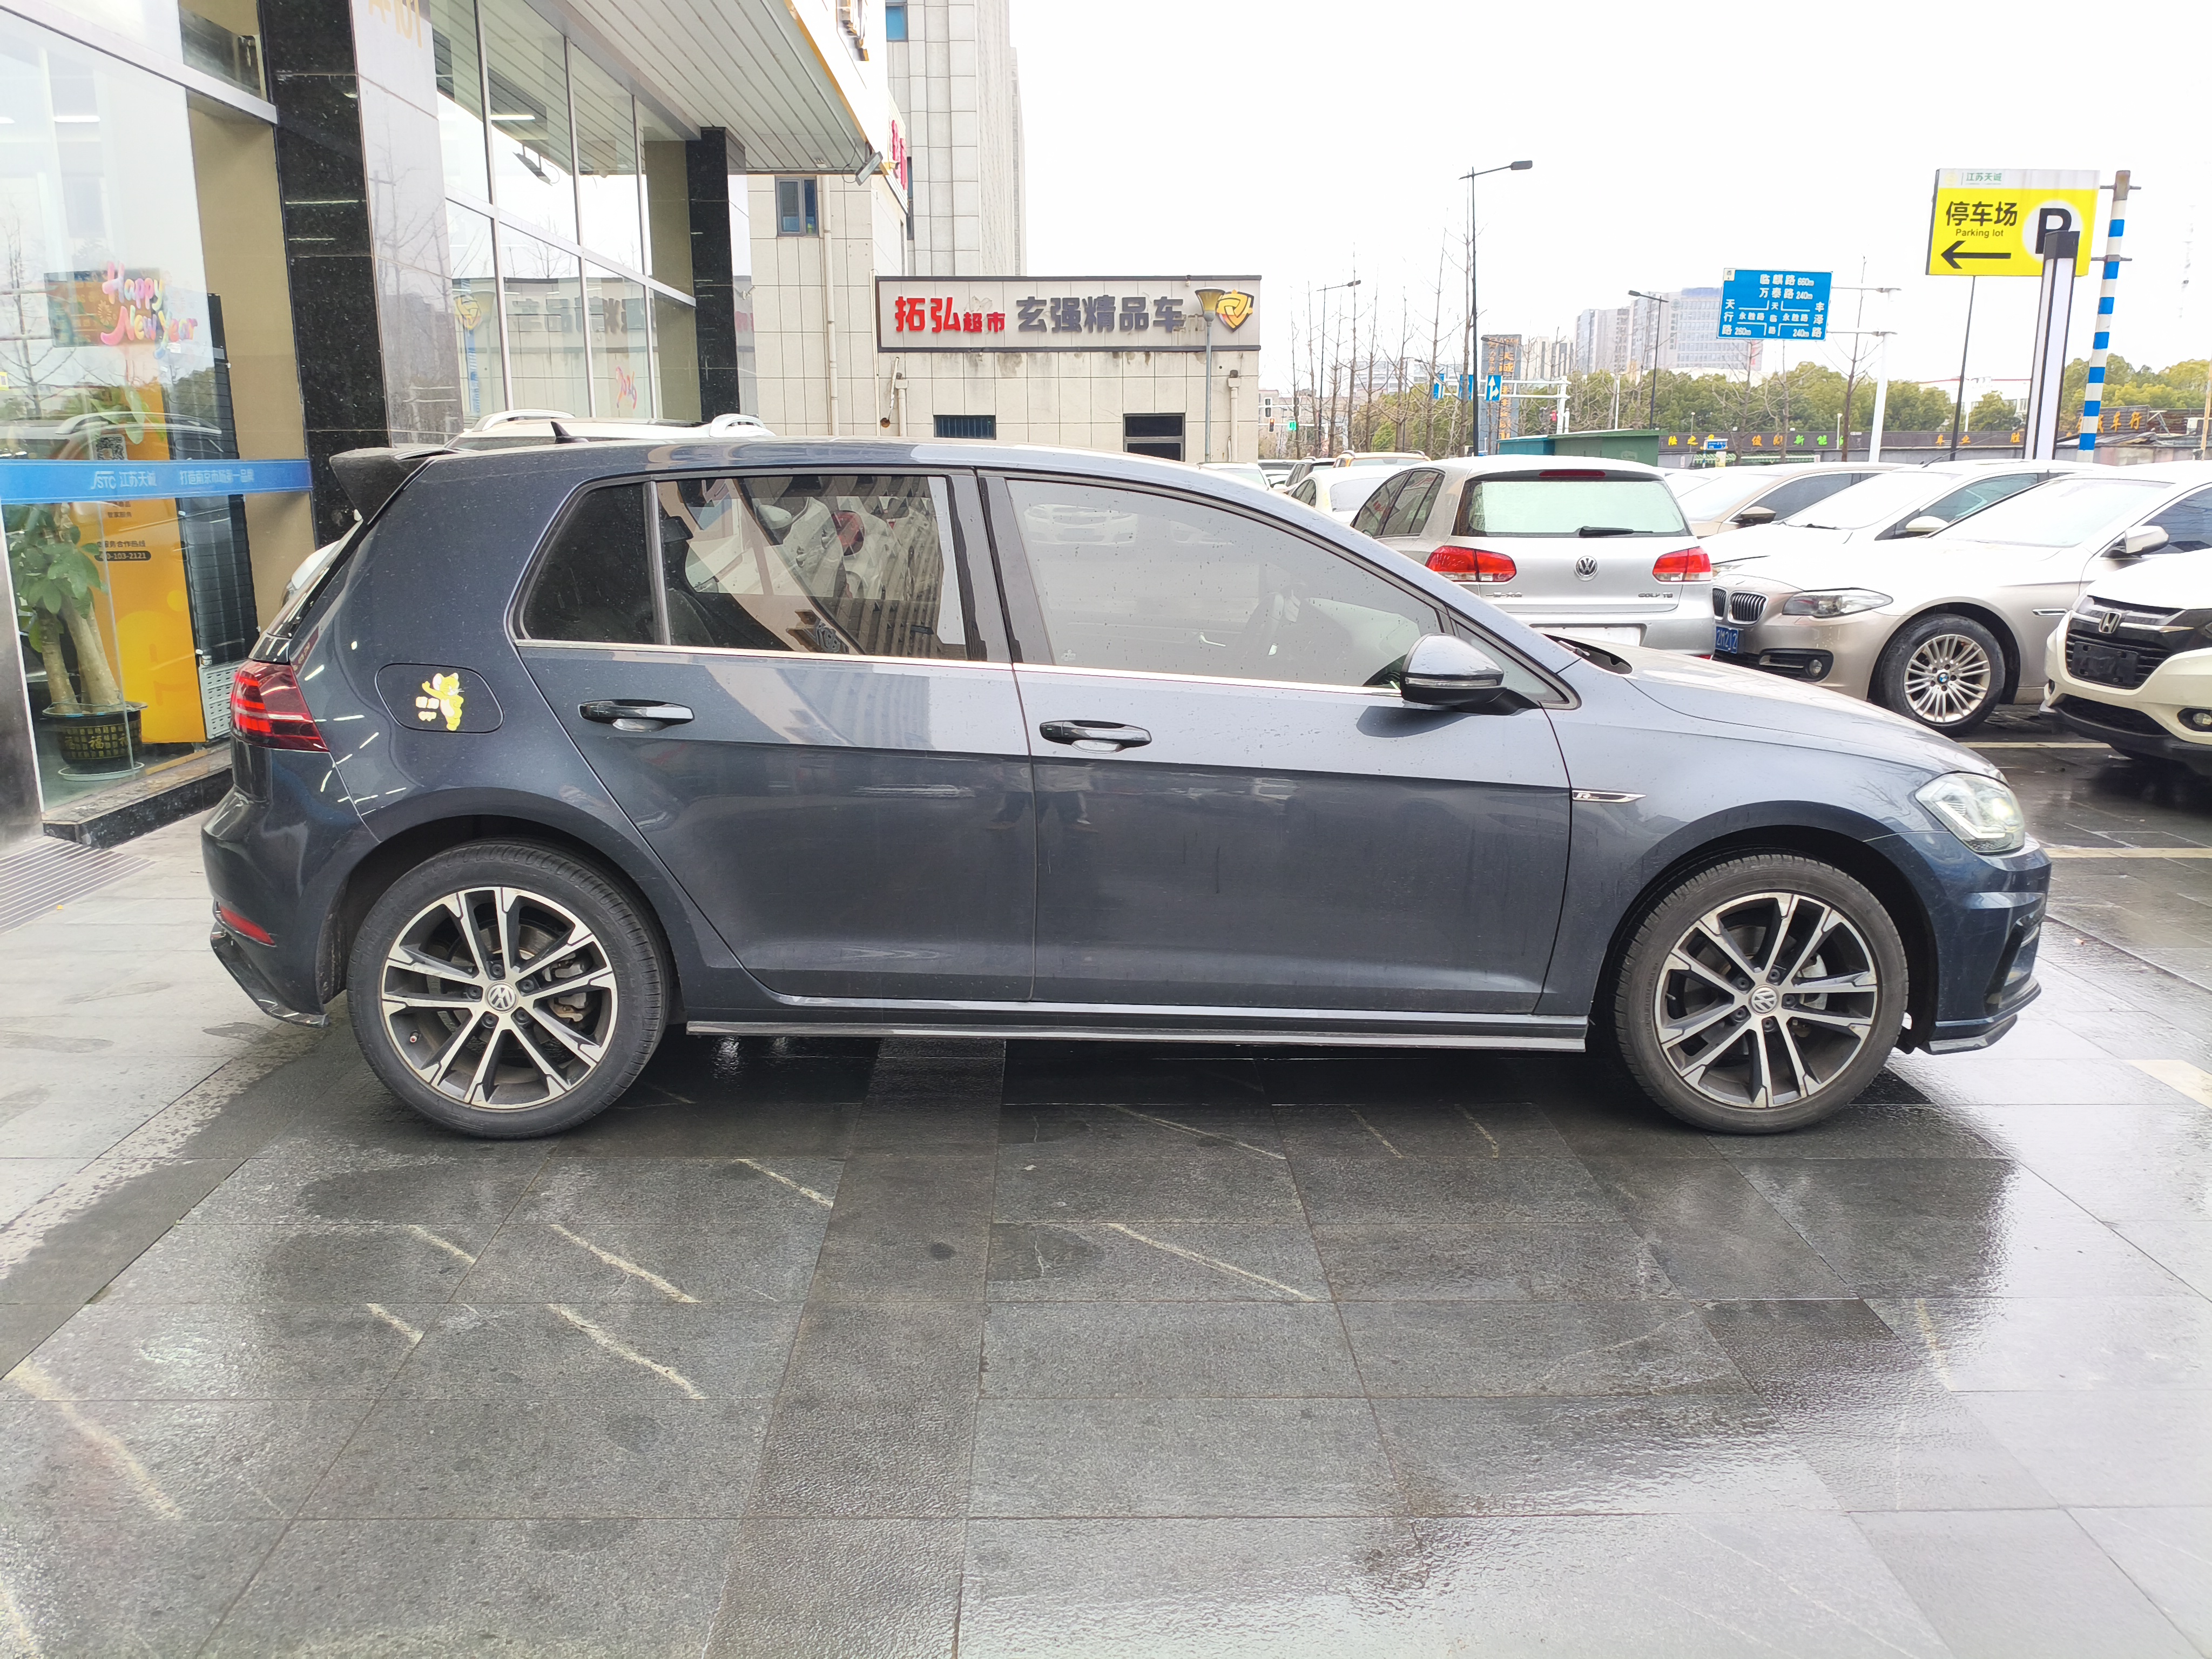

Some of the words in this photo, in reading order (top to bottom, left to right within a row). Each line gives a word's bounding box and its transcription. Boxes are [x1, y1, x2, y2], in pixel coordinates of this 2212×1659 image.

[1946, 201, 2018, 227] 停车场
[2035, 208, 2072, 254] P
[1955, 228, 1990, 238] Parking
[1993, 228, 2004, 237] lot
[102, 261, 164, 311] Happy
[1759, 287, 1794, 299] 万泰路
[100, 305, 157, 346] New
[154, 308, 198, 359] Year
[895, 296, 1006, 333] 拓弘超市
[1016, 294, 1185, 333] 玄强精品车
[1722, 299, 1735, 335] 天行路
